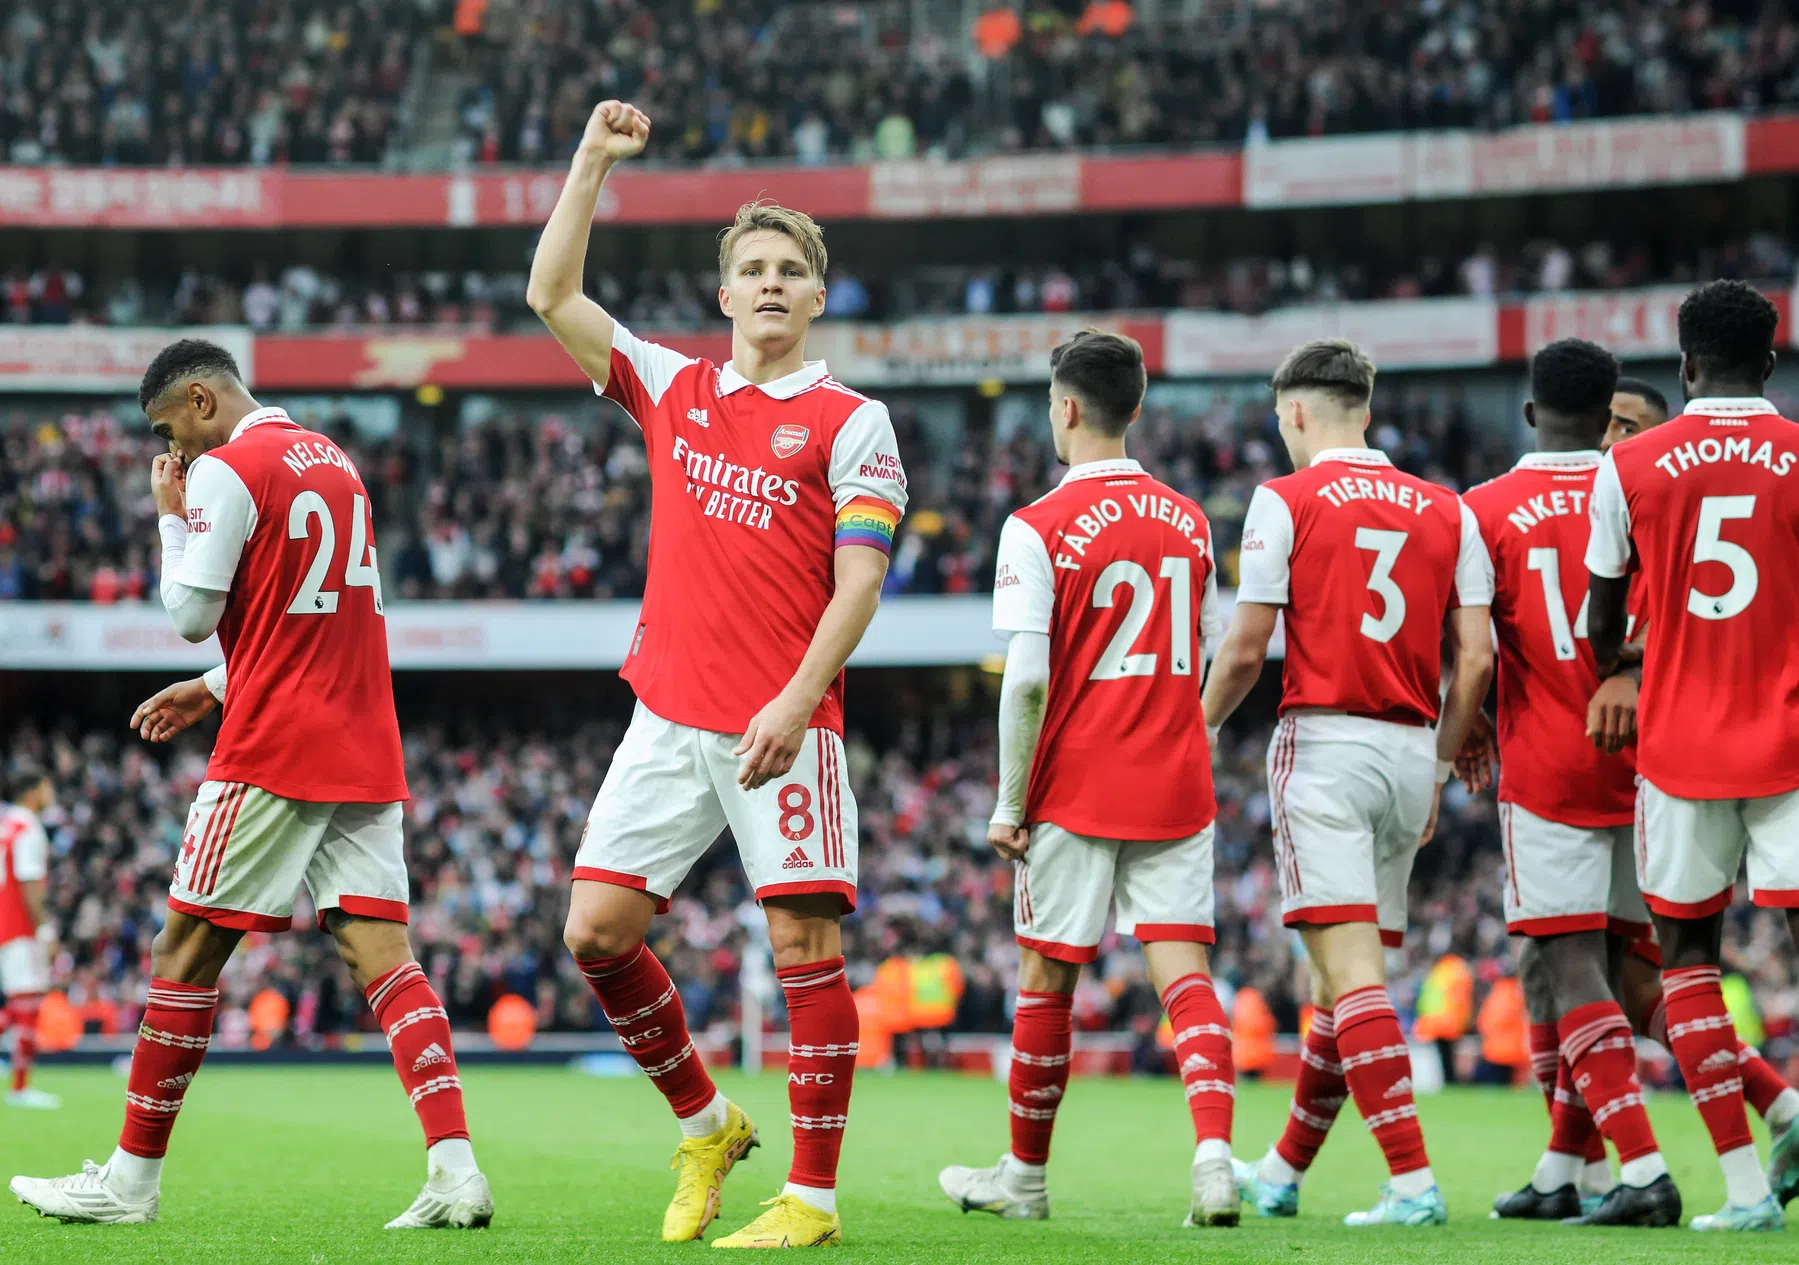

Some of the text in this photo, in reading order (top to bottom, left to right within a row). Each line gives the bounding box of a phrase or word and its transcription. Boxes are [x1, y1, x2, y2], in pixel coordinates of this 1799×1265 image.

[282, 441, 357, 481] NELSON
[672, 436, 800, 506] Emirates
[1655, 436, 1798, 477] THOMAS
[703, 490, 773, 530] BETTER
[1317, 477, 1433, 516] TIERNEY
[1507, 490, 1588, 534] NKET
[850, 514, 893, 536] Capt
[1055, 494, 1206, 571] FÁBIO VIEIRA
[286, 490, 384, 617] 24
[1687, 495, 1759, 620] 5
[1354, 526, 1409, 643] 3
[1089, 556, 1192, 681] 21
[777, 783, 815, 842] 8
[782, 859, 814, 869] adidas
[618, 1026, 663, 1046] AFC
[788, 1072, 834, 1085] AFC
